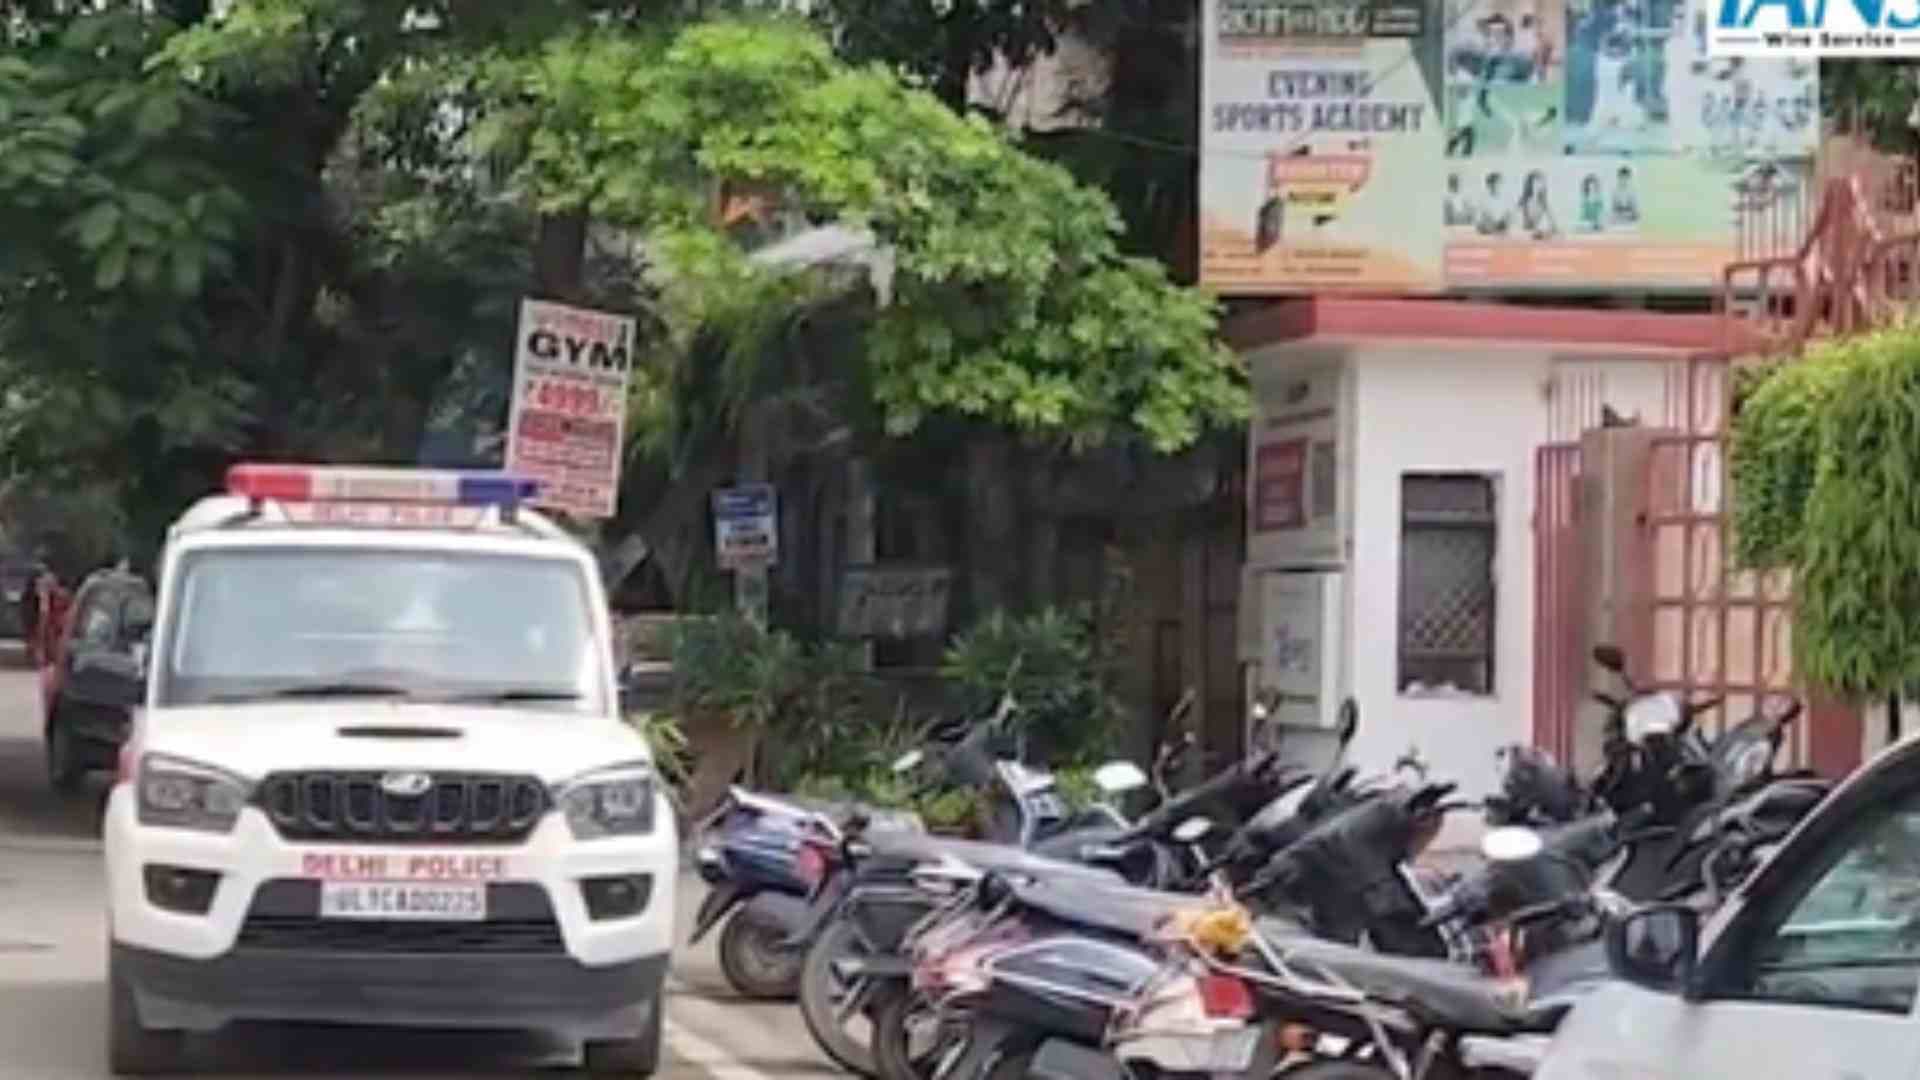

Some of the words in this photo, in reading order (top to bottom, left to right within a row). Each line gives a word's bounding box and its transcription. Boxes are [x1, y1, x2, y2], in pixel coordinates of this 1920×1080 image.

[1268, 69, 1372, 98] EVENING
[1213, 102, 1303, 132] SPORTS
[1310, 102, 1424, 132] ACADEMY
[528, 330, 629, 372] GYM
[302, 854, 388, 876] DELHI
[408, 856, 507, 878] POLICE
